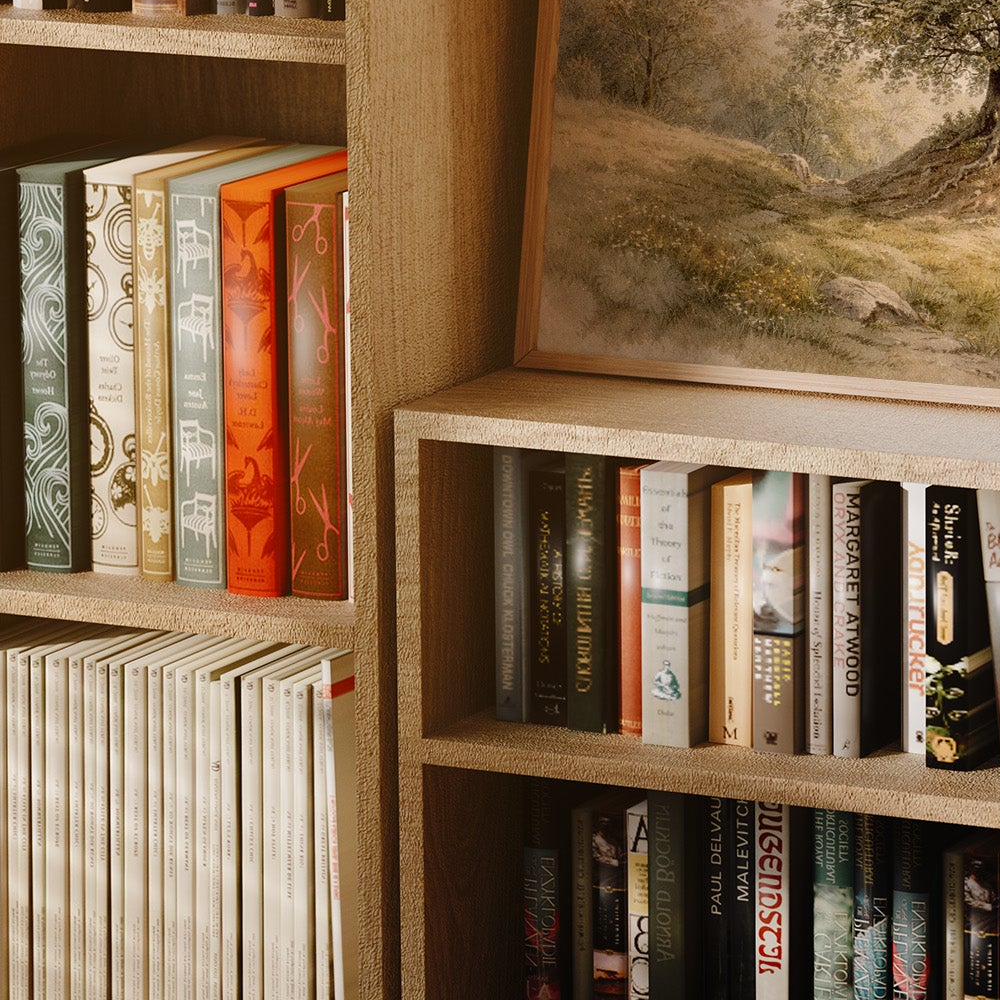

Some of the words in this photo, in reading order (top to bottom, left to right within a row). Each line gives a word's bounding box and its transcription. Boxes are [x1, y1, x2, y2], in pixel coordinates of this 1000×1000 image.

[833, 491, 846, 543] ORYX
[833, 549, 846, 584] AND
[846, 493, 860, 603] MARGARET
[833, 599, 846, 668] CRAKE
[846, 609, 860, 697] ATWOOD
[723, 728, 738, 740] M
[710, 797, 722, 865] DELVAU
[711, 871, 722, 916] PAUL
